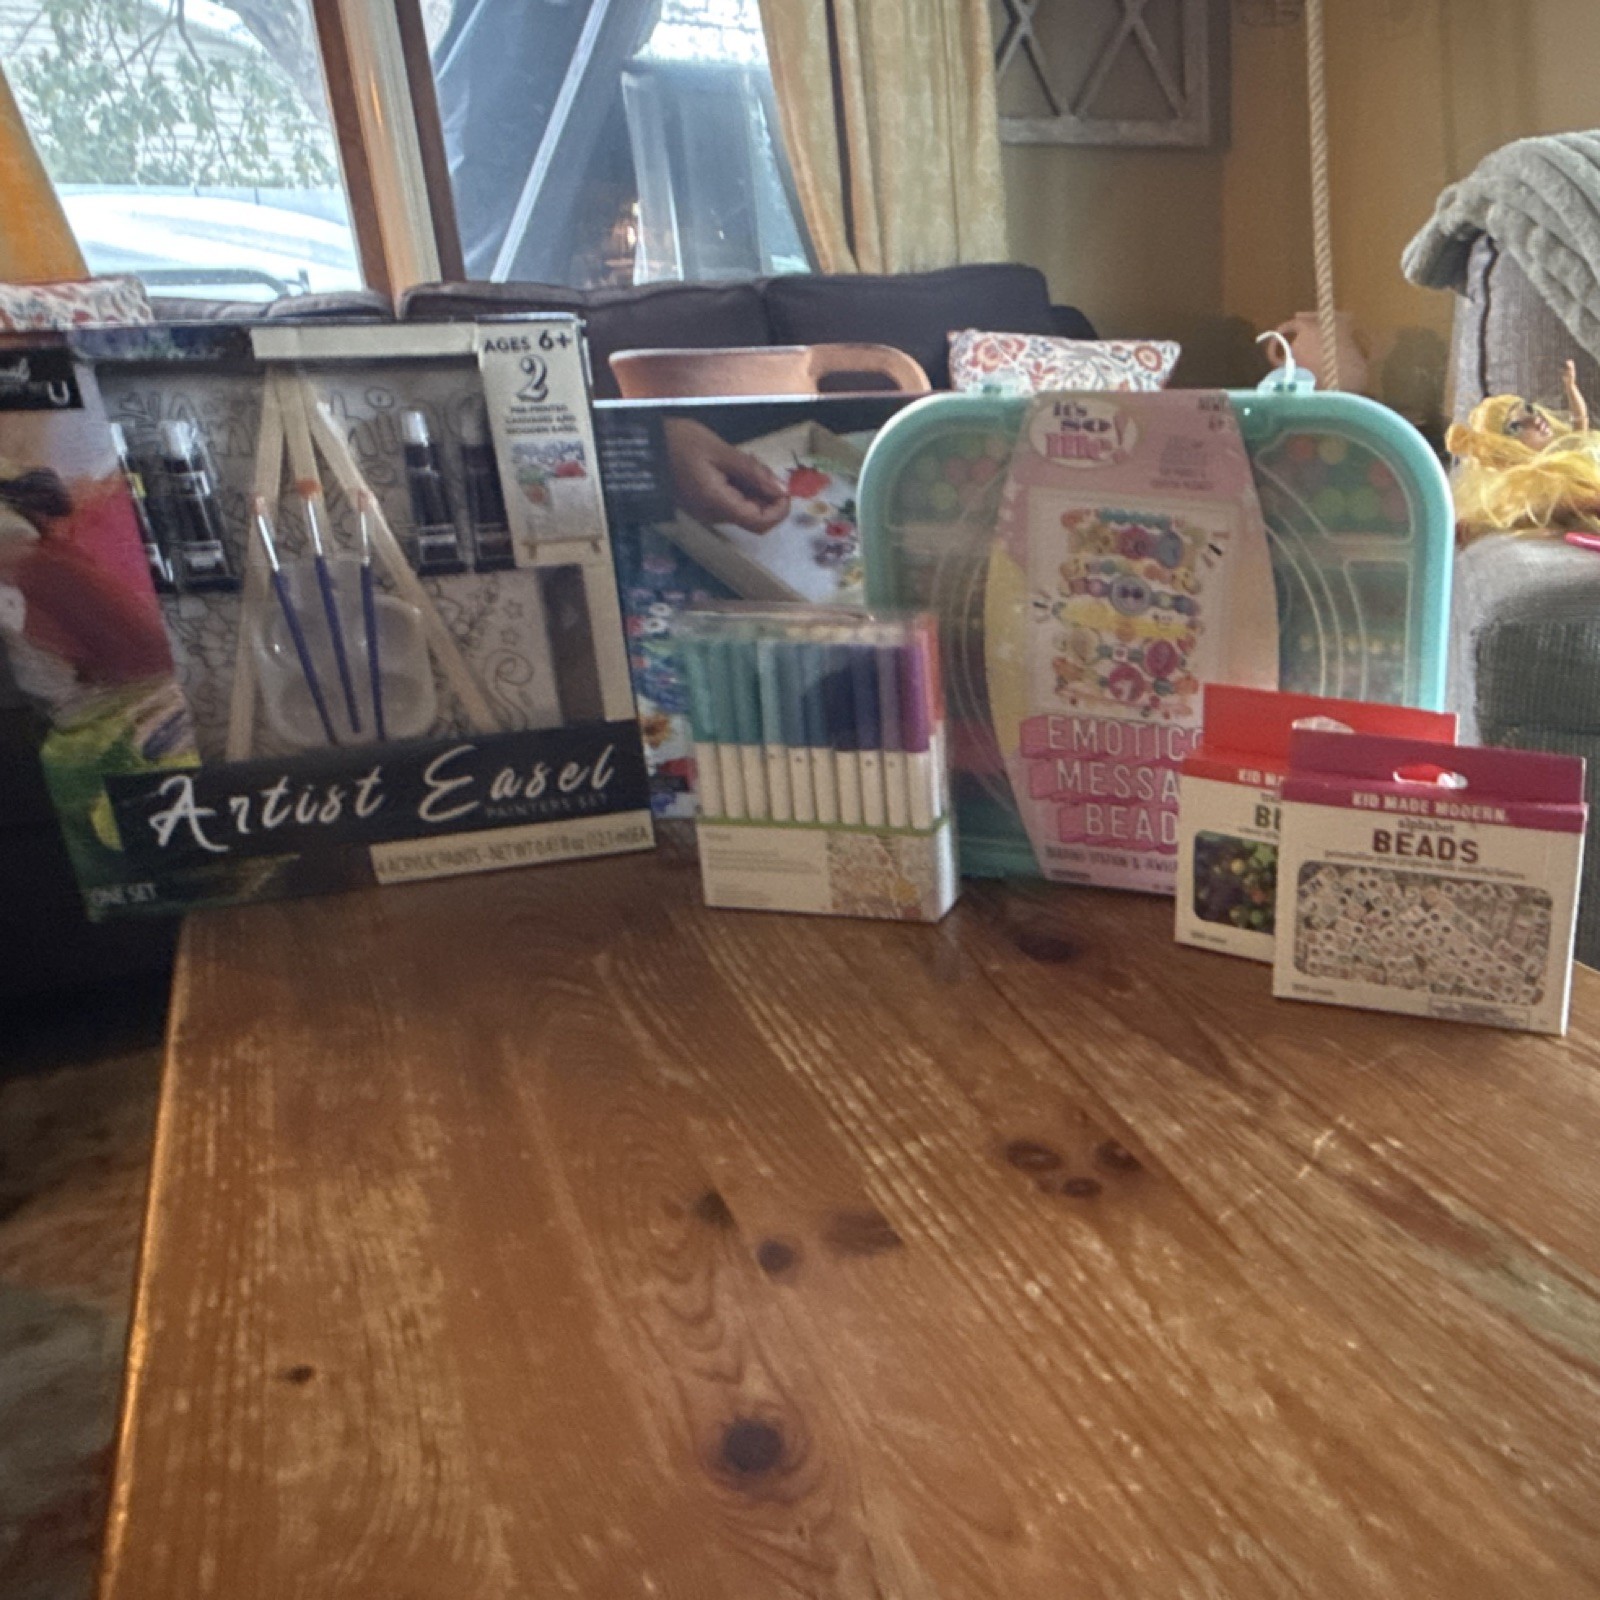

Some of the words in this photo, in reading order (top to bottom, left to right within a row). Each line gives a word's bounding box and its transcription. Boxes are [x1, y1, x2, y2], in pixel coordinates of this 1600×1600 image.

[485, 336, 531, 353] AGES
[538, 329, 571, 351] 6+
[517, 355, 550, 402] 2
[148, 765, 386, 853] Artist
[418, 743, 615, 822] Easel
[1351, 790, 1380, 809] KID
[1384, 793, 1430, 814] MADE
[1372, 828, 1480, 865] BEADS
